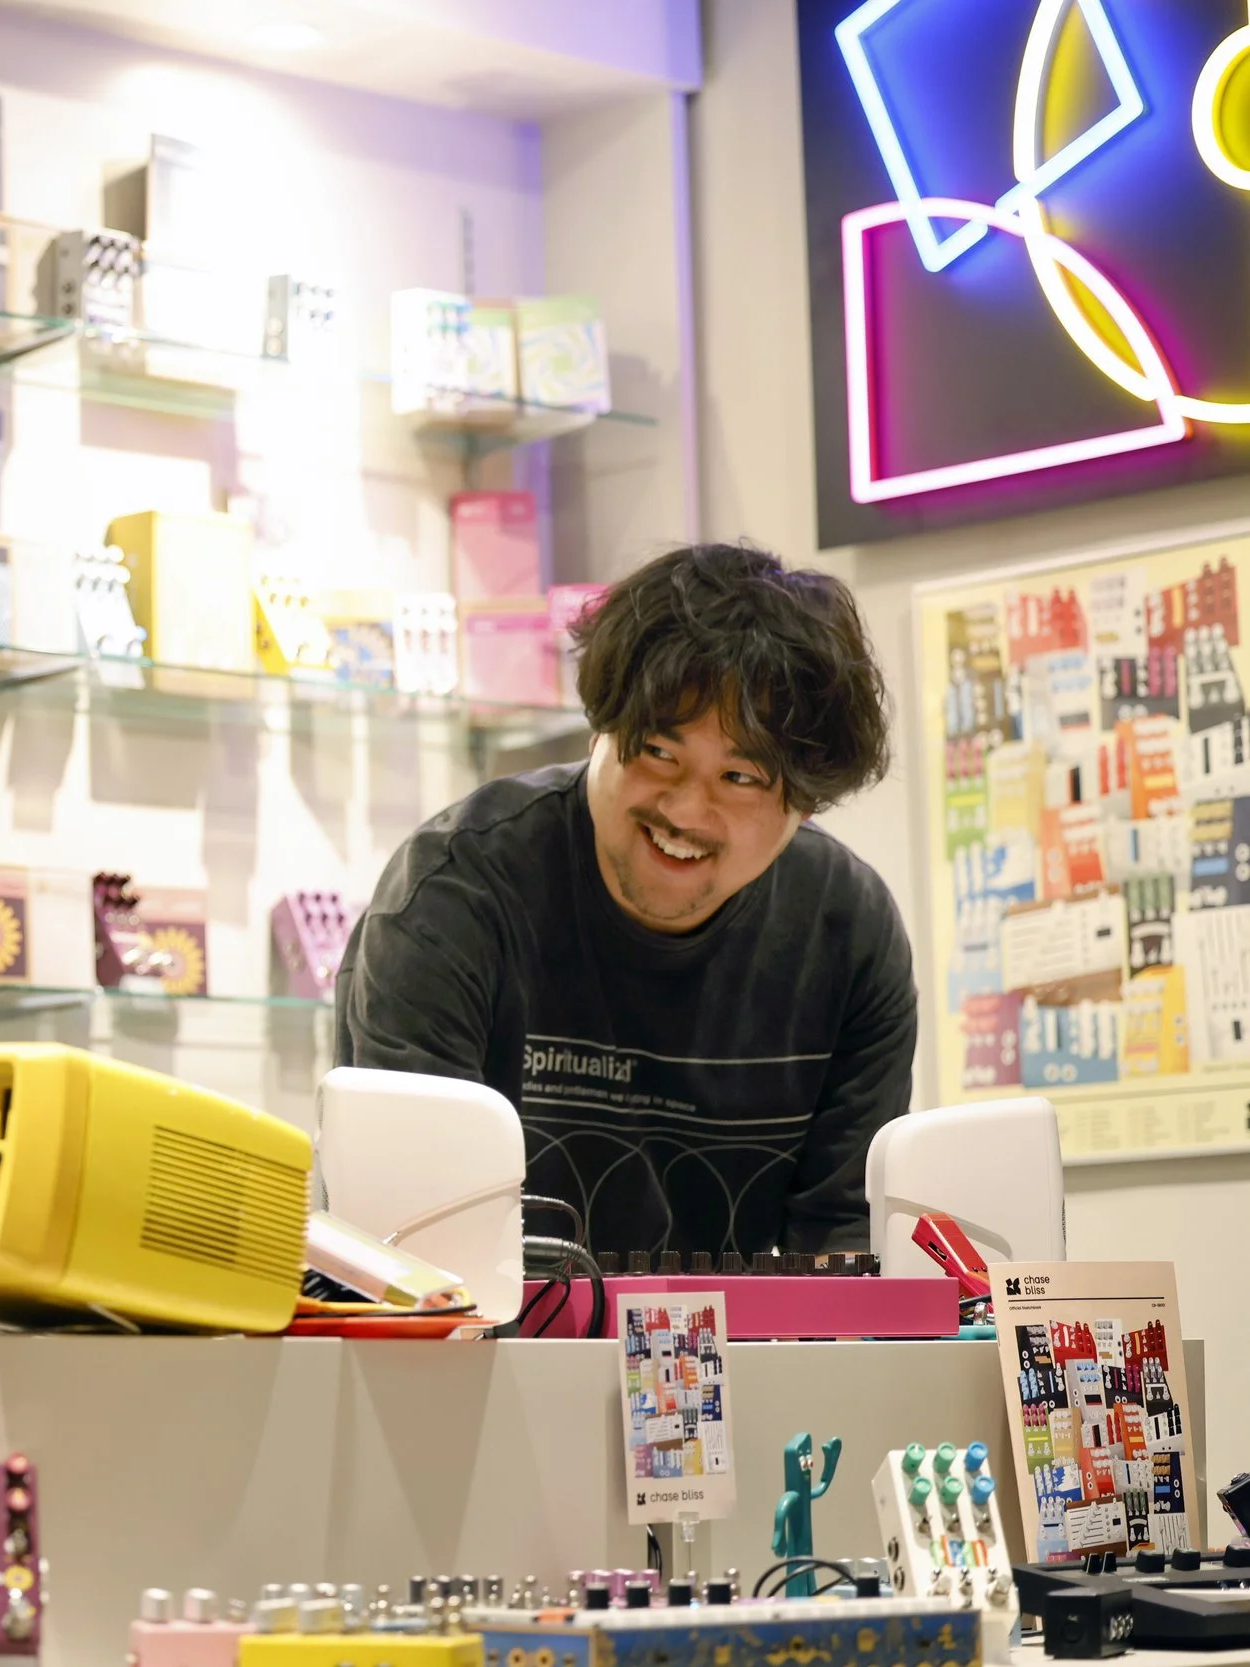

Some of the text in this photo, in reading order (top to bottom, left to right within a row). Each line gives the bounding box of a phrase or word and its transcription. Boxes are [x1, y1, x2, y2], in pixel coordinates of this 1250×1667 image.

[522, 1081, 543, 1093] adies
[1023, 1275, 1050, 1285] chase
[1024, 1285, 1046, 1295] bliss
[650, 1489, 704, 1502] chase bliss
